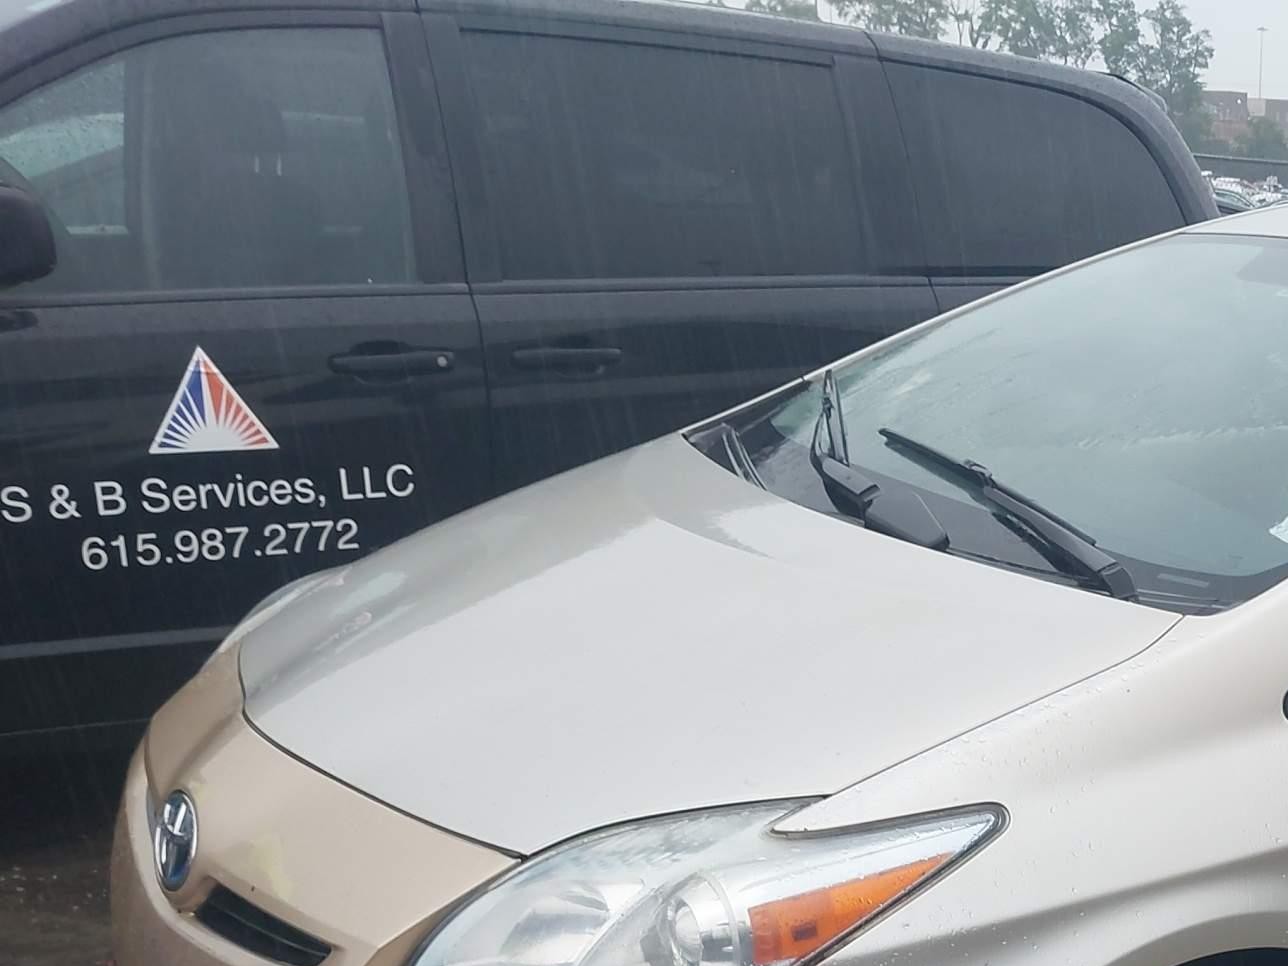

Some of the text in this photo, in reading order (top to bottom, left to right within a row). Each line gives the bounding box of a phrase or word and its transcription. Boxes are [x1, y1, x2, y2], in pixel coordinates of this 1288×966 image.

[0, 463, 415, 523] S & B Services, LLC
[81, 518, 360, 570] 615.987.2772
